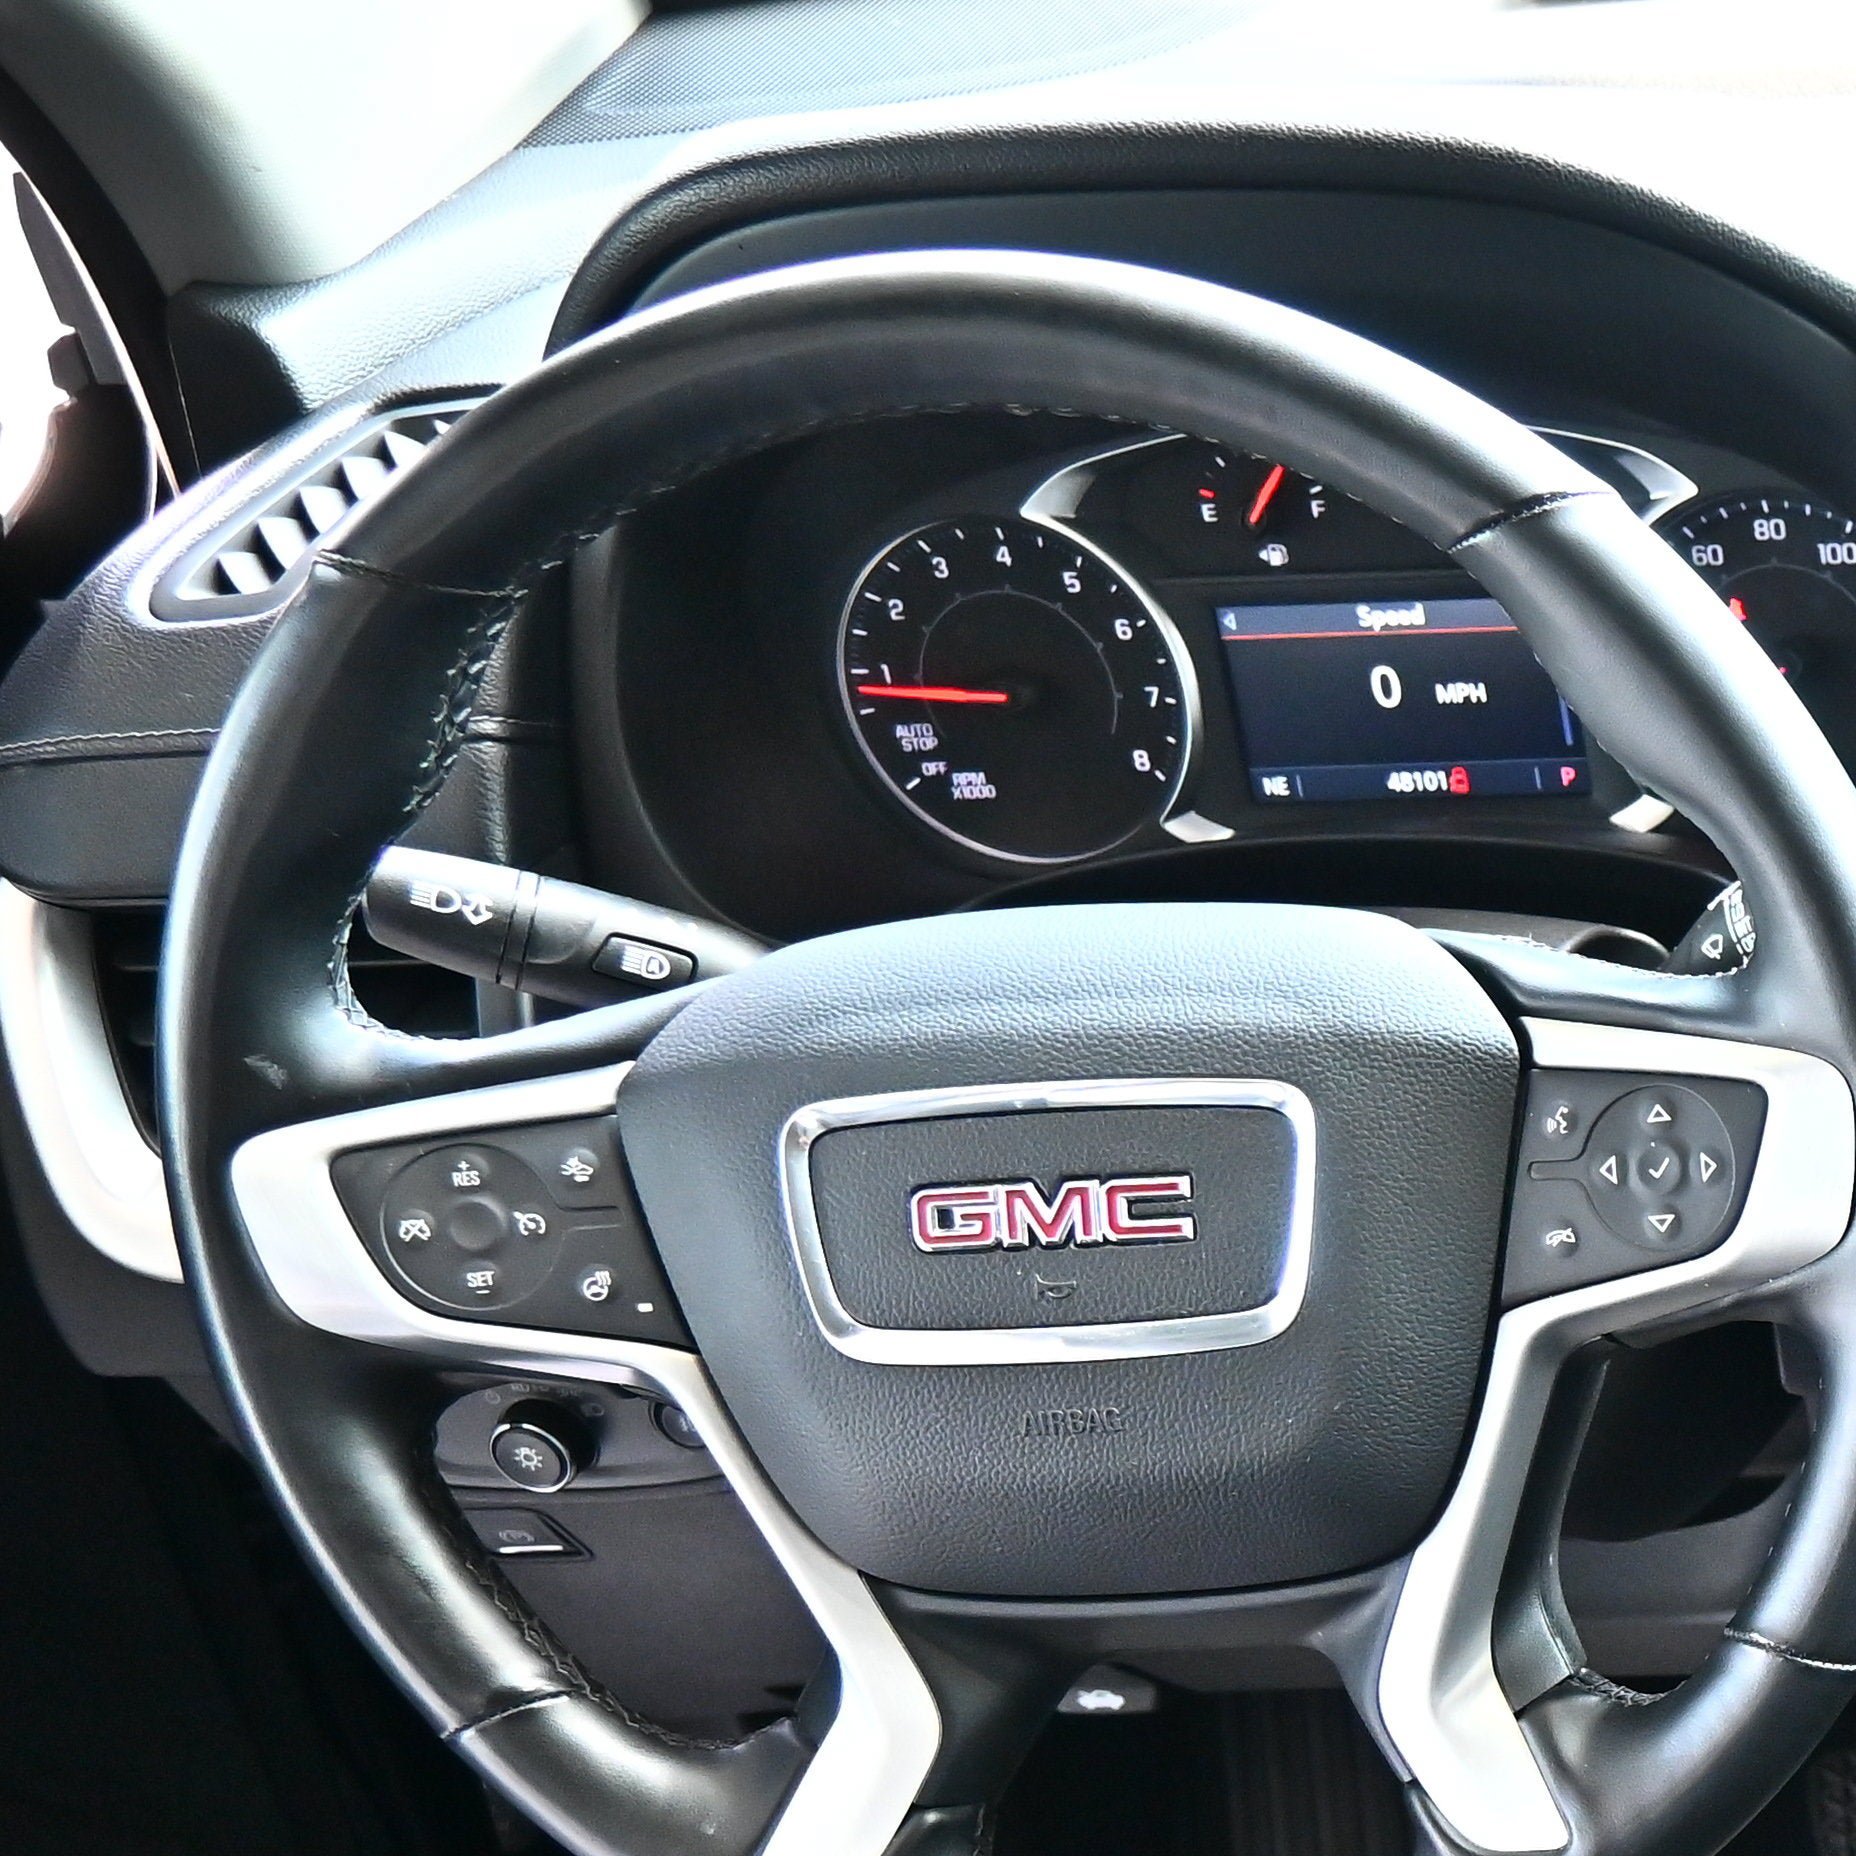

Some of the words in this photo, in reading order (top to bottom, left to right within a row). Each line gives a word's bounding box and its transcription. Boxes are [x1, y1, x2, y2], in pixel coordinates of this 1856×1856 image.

[1201, 503, 1218, 522] E
[1311, 499, 1325, 519] F
[1754, 519, 1785, 542] 80
[995, 545, 1013, 567] 4
[1691, 544, 1723, 566] 60
[931, 558, 949, 579] 3
[1062, 571, 1080, 592] 5
[889, 599, 905, 621] 2
[1356, 604, 1426, 631] Speed
[1114, 618, 1132, 641] 6
[881, 664, 891, 684] 1
[1146, 686, 1161, 707] 7
[1370, 666, 1402, 709] 0
[1435, 682, 1487, 705] MPH
[896, 723, 933, 740] AUTO
[902, 736, 938, 752] STOP
[922, 761, 948, 776] OFF
[1132, 749, 1150, 772] 8
[952, 772, 987, 787] RPM
[1261, 776, 1289, 798] NE
[1387, 770, 1448, 794] 48101
[1560, 766, 1576, 787] P
[453, 1170, 480, 1187] RES
[910, 1175, 1194, 1252] GMC
[466, 1272, 494, 1288] SET
[1023, 1407, 1123, 1437] AIRBAG
